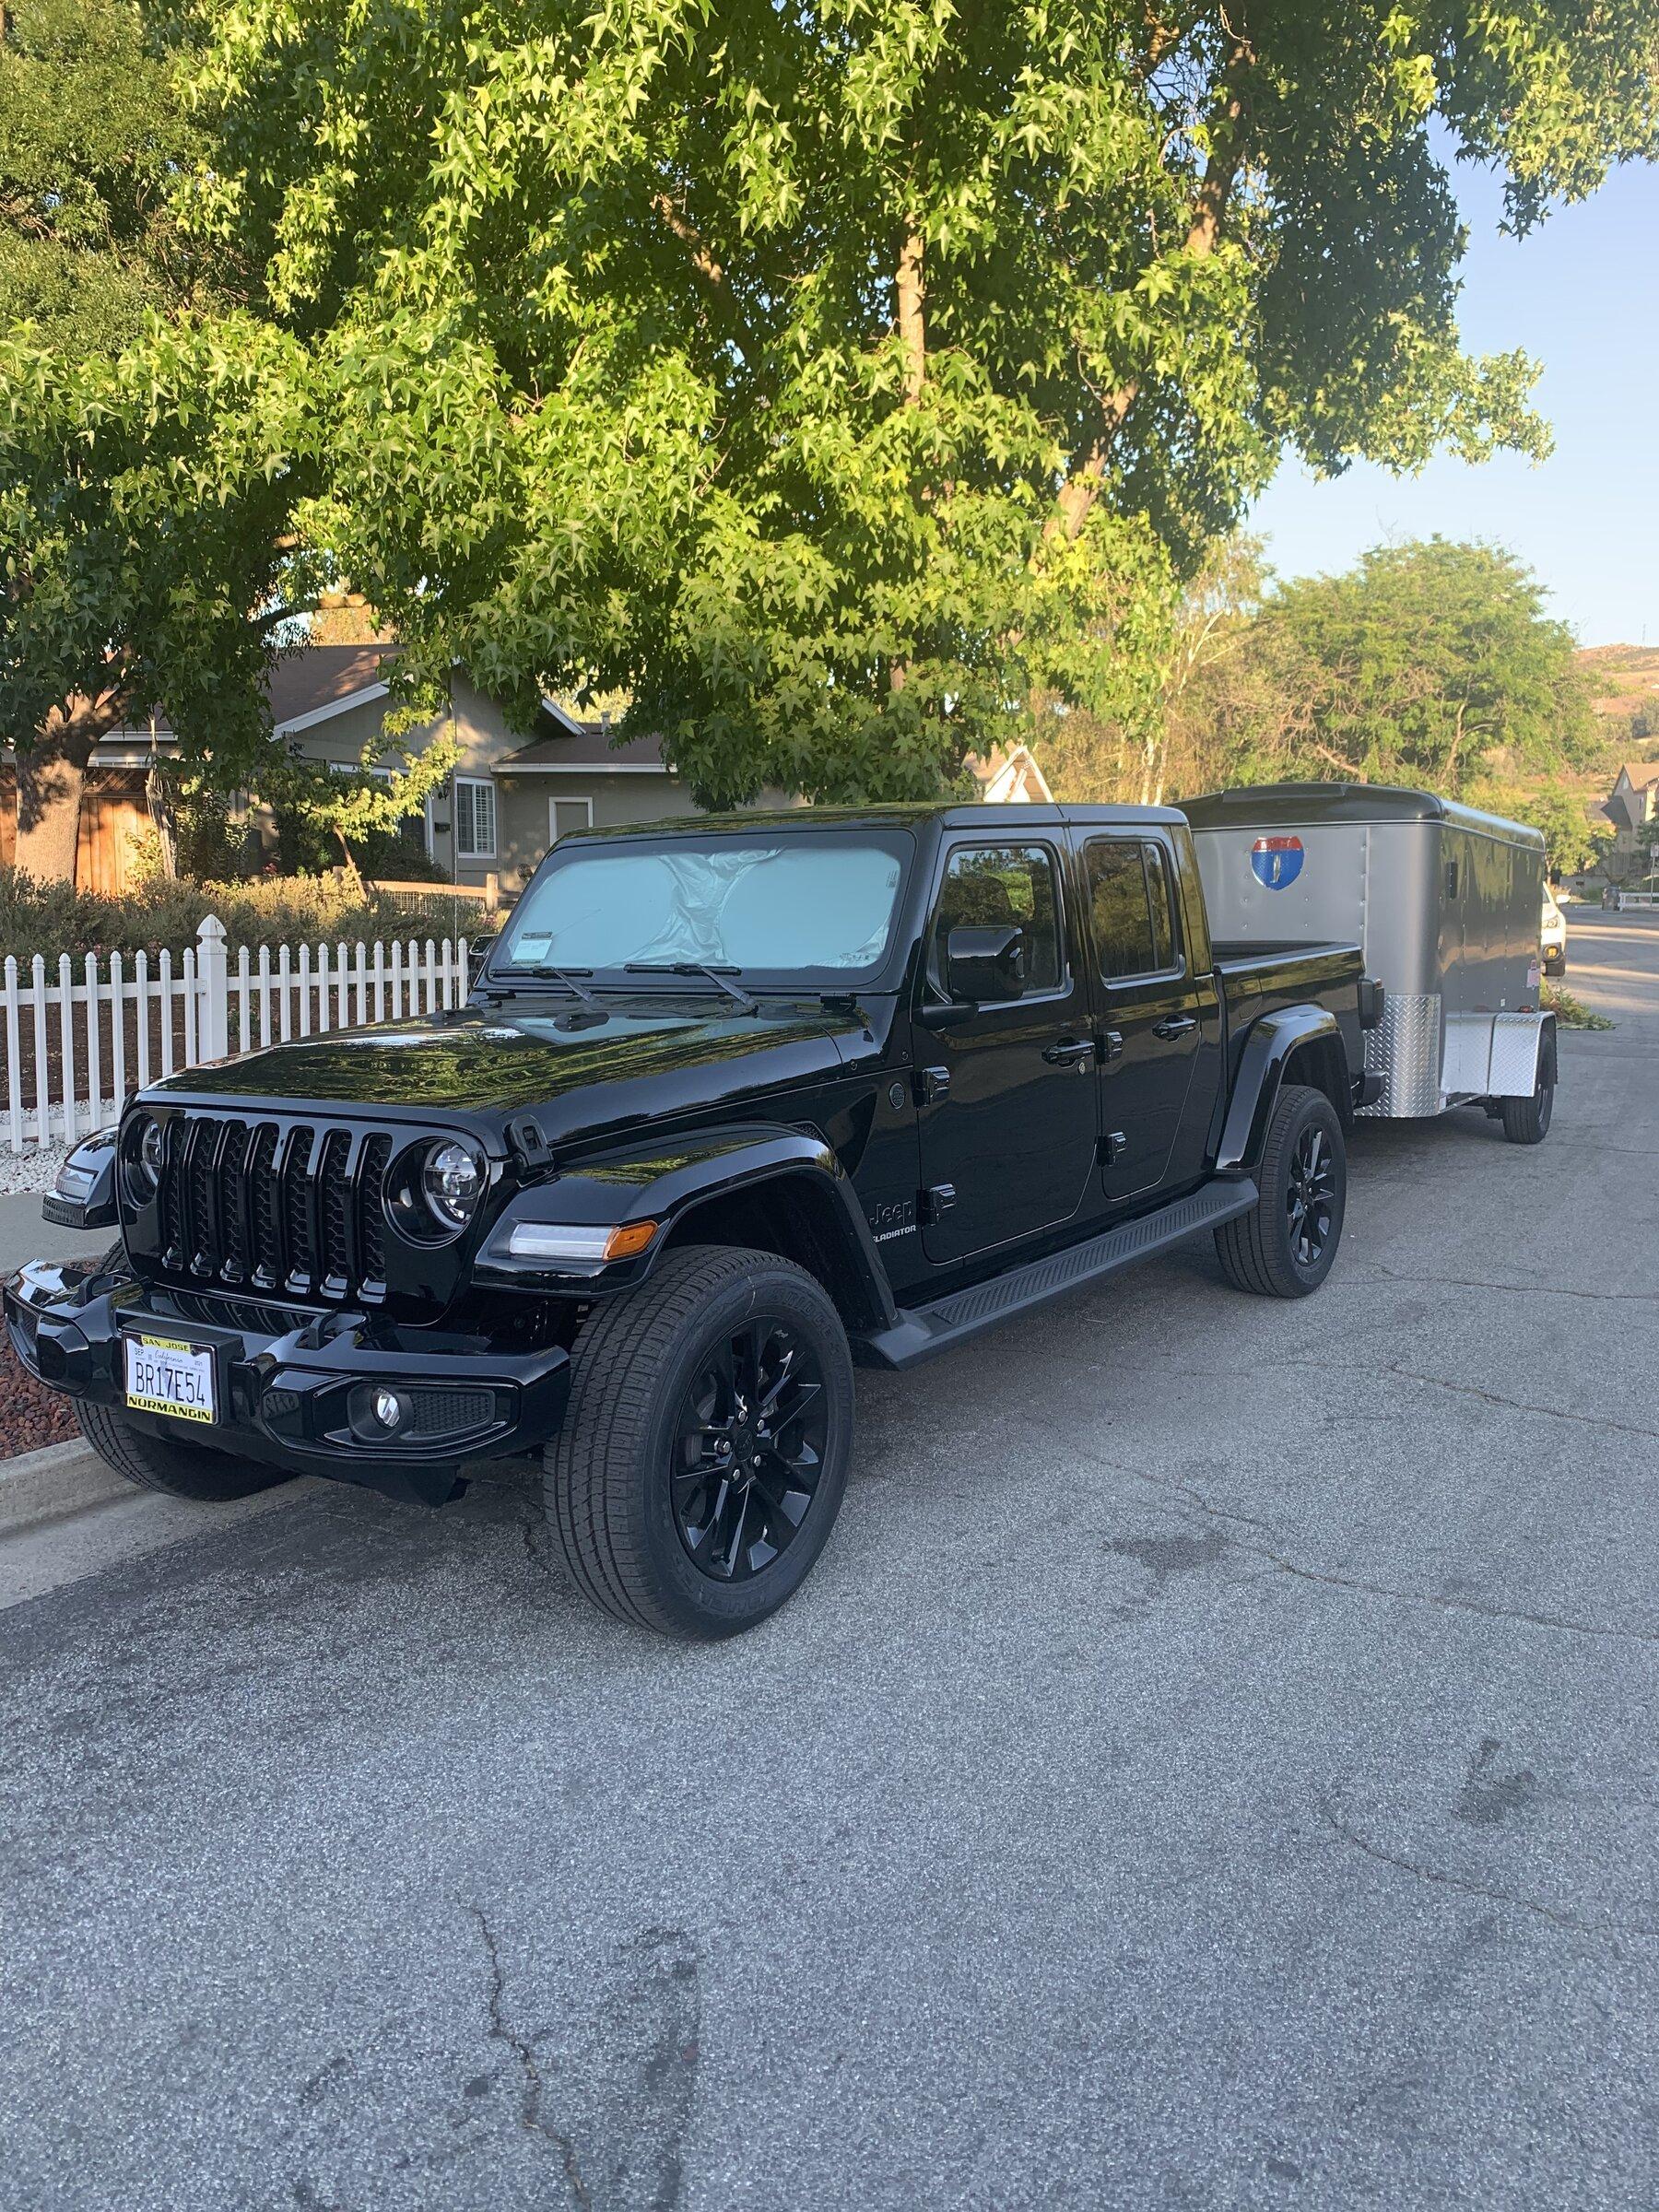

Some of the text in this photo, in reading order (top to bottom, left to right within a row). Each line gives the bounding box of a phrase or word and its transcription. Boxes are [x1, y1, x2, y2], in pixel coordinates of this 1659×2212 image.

[869, 1200, 912, 1228] Jeep
[142, 1337, 190, 1352] SAN JOSE
[135, 1361, 206, 1406] BR17E54
